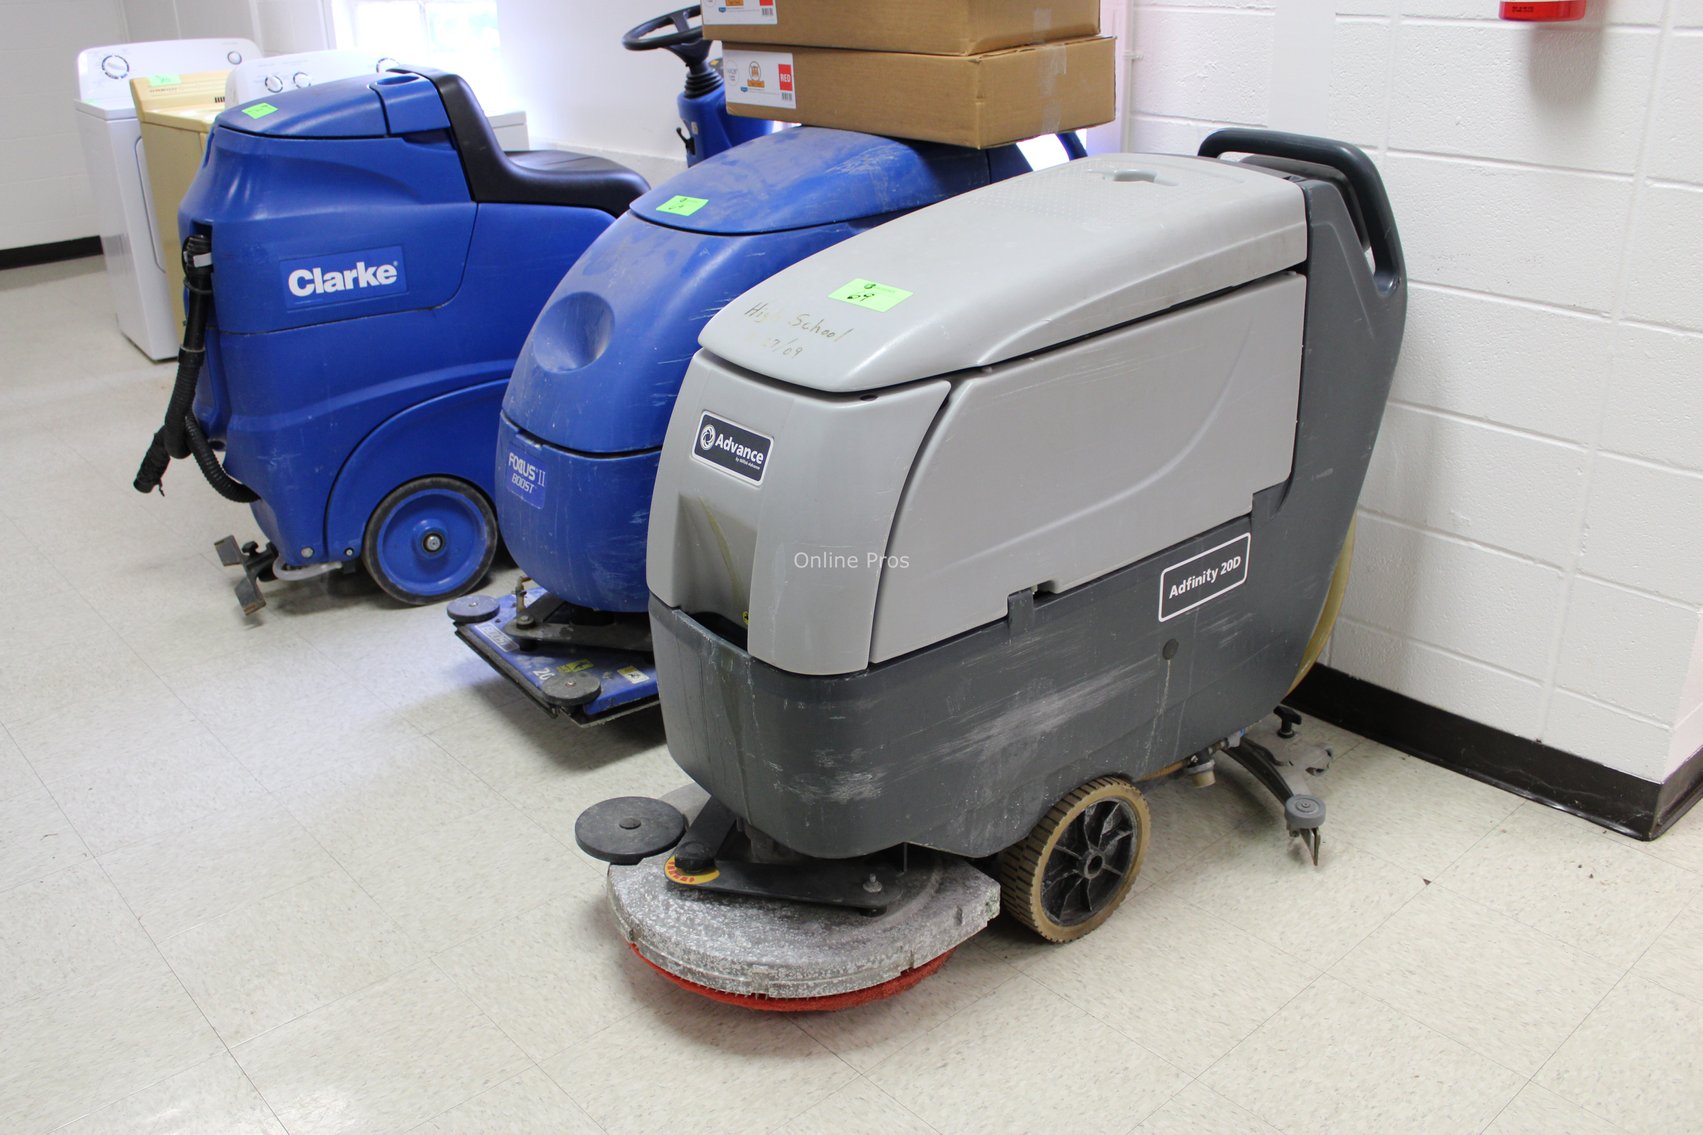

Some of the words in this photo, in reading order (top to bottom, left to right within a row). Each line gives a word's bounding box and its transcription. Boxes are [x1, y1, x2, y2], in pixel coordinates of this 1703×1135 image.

[780, 73, 791, 83] RED
[288, 261, 397, 297] Clarke
[790, 313, 854, 342] School
[715, 433, 764, 465] Advance
[511, 473, 535, 494] BOOST
[1168, 567, 1219, 599] Adfinity
[1220, 555, 1241, 576] 20D
